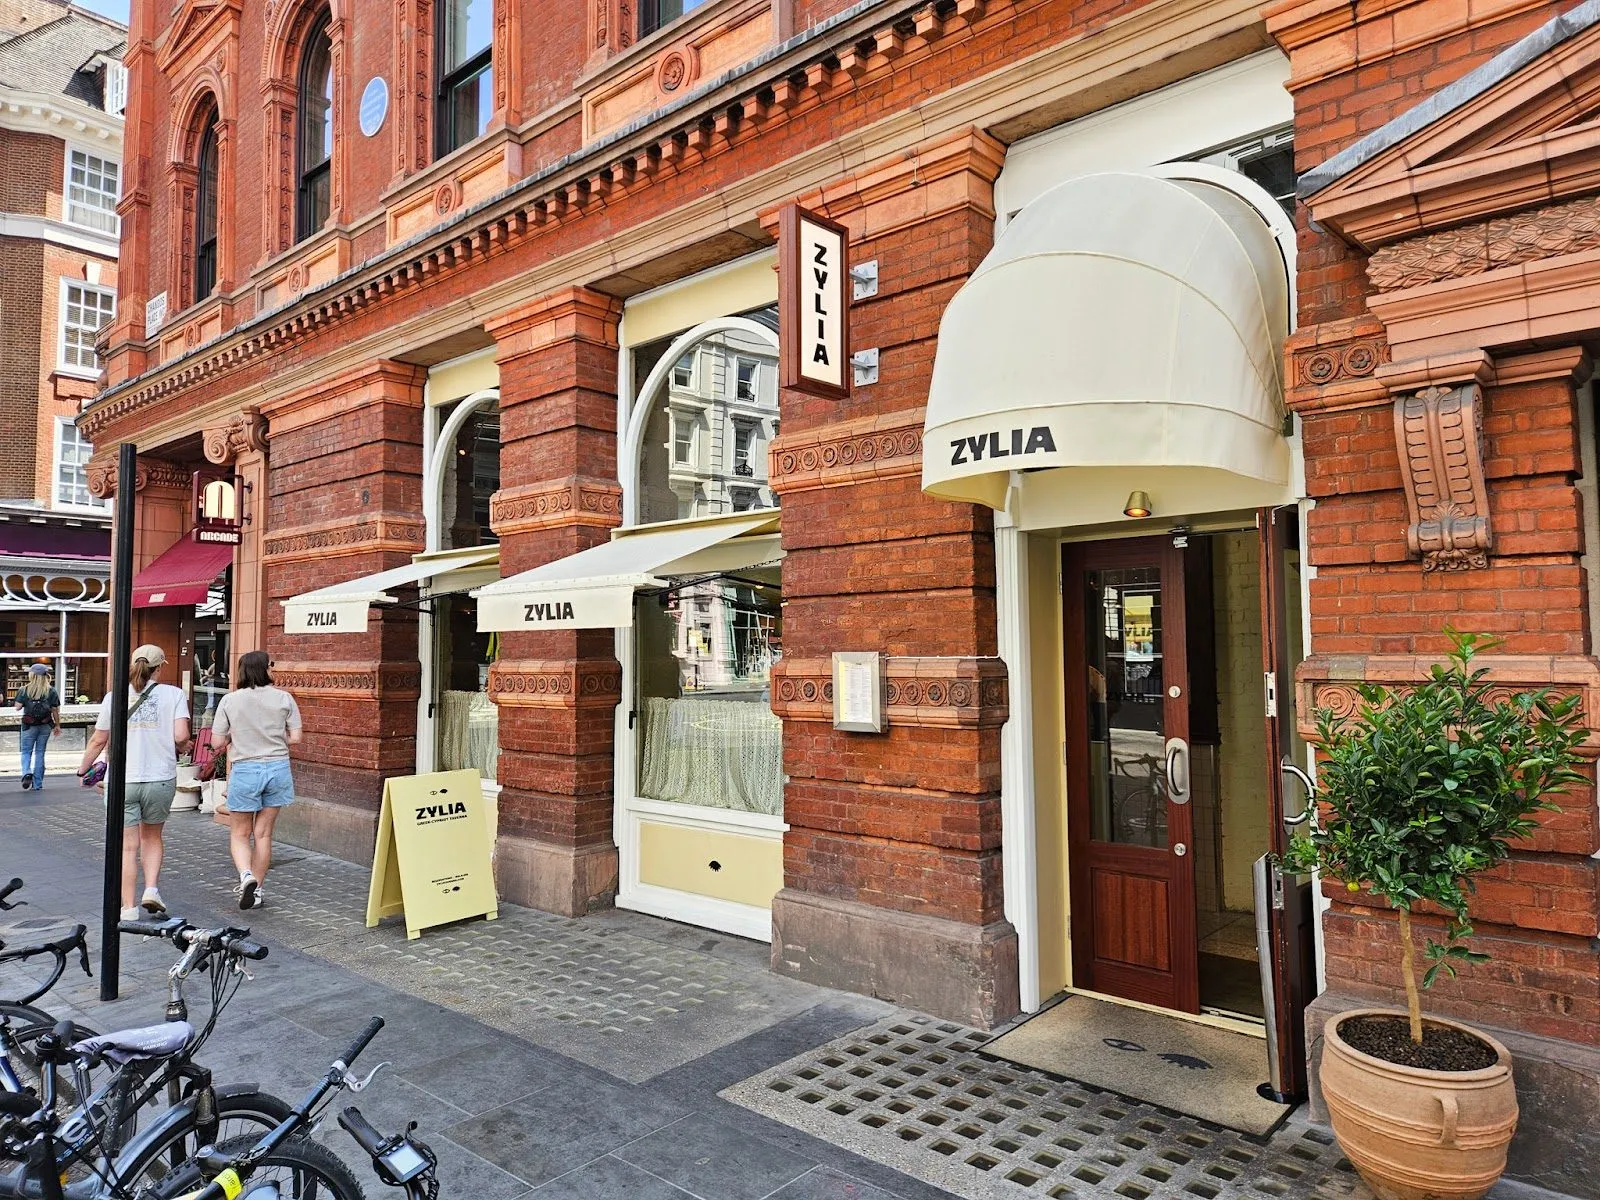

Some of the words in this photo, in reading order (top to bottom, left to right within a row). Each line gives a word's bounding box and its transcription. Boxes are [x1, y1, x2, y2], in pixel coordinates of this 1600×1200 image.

[813, 242, 830, 367] ZYLIA
[950, 426, 1057, 466] ZYLIA
[200, 531, 240, 543] ARCADE
[306, 612, 337, 626] ZYLIA
[523, 602, 575, 621] ZYLIA
[415, 802, 467, 819] ZYLIA
